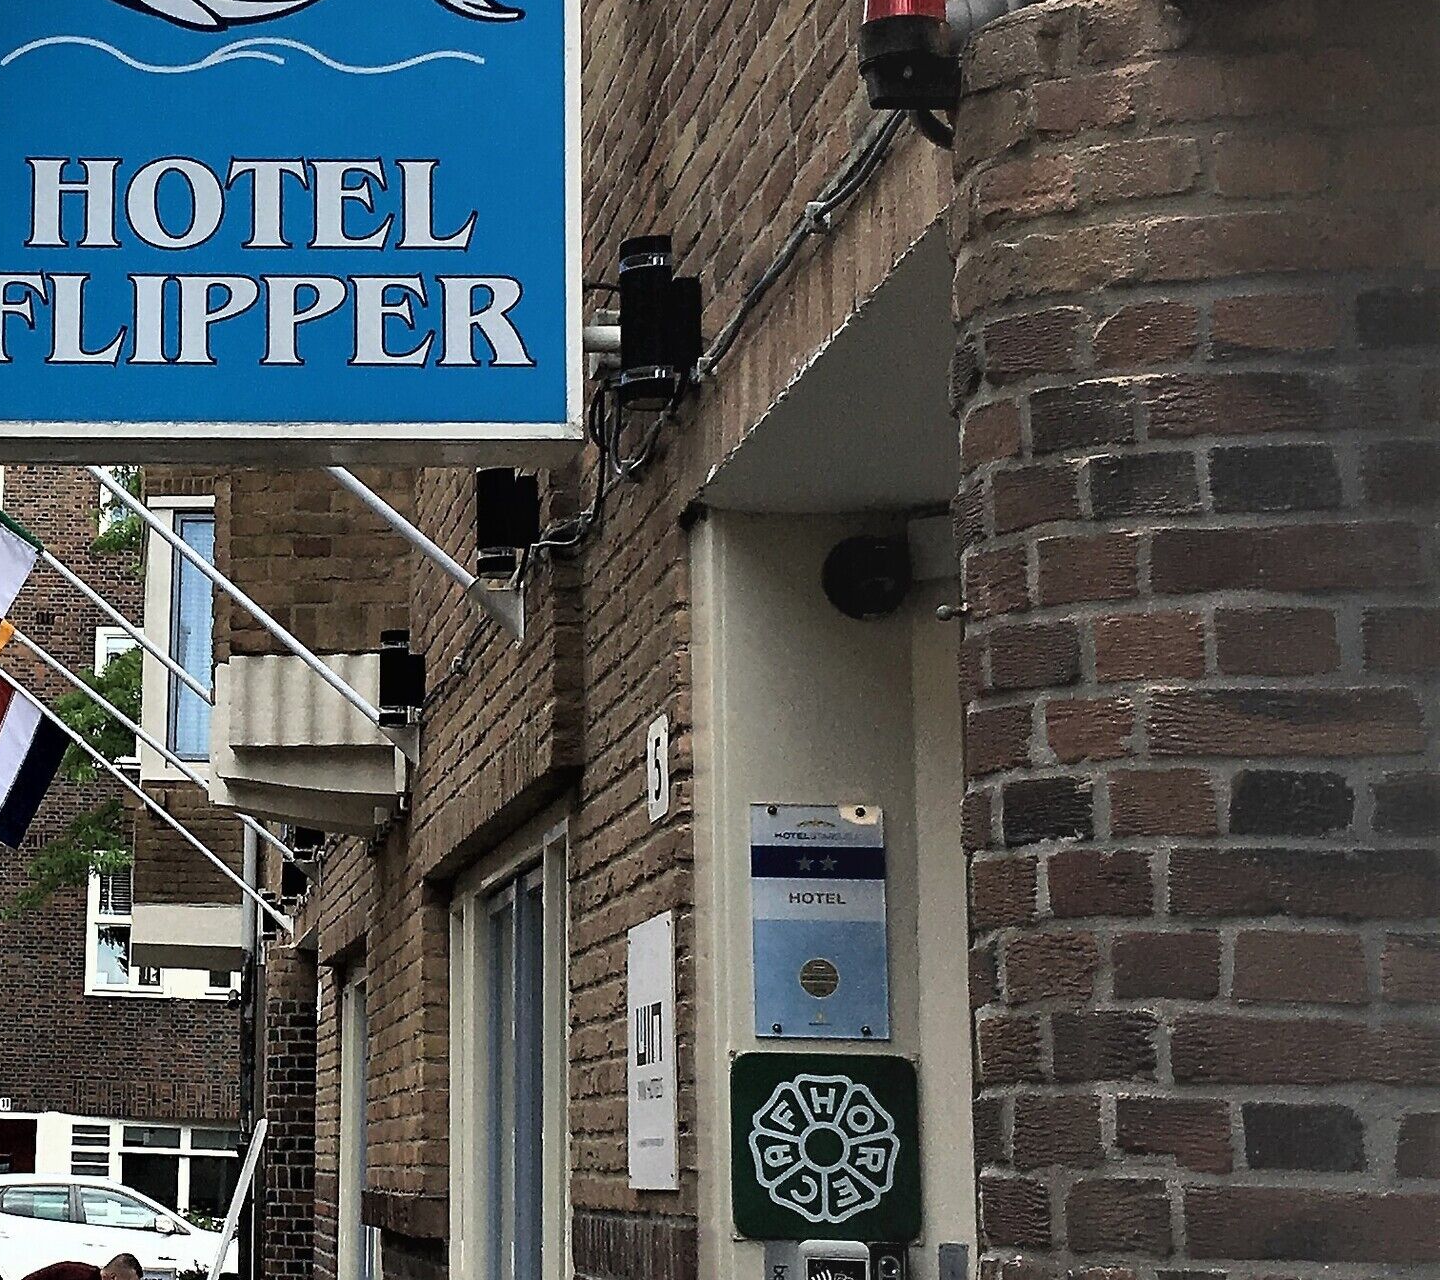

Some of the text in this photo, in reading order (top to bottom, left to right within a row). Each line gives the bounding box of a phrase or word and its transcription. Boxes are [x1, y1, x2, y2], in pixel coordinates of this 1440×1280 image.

[25, 156, 479, 252] HOTEL
[654, 736, 662, 801] 5
[788, 892, 847, 905] HOTEL
